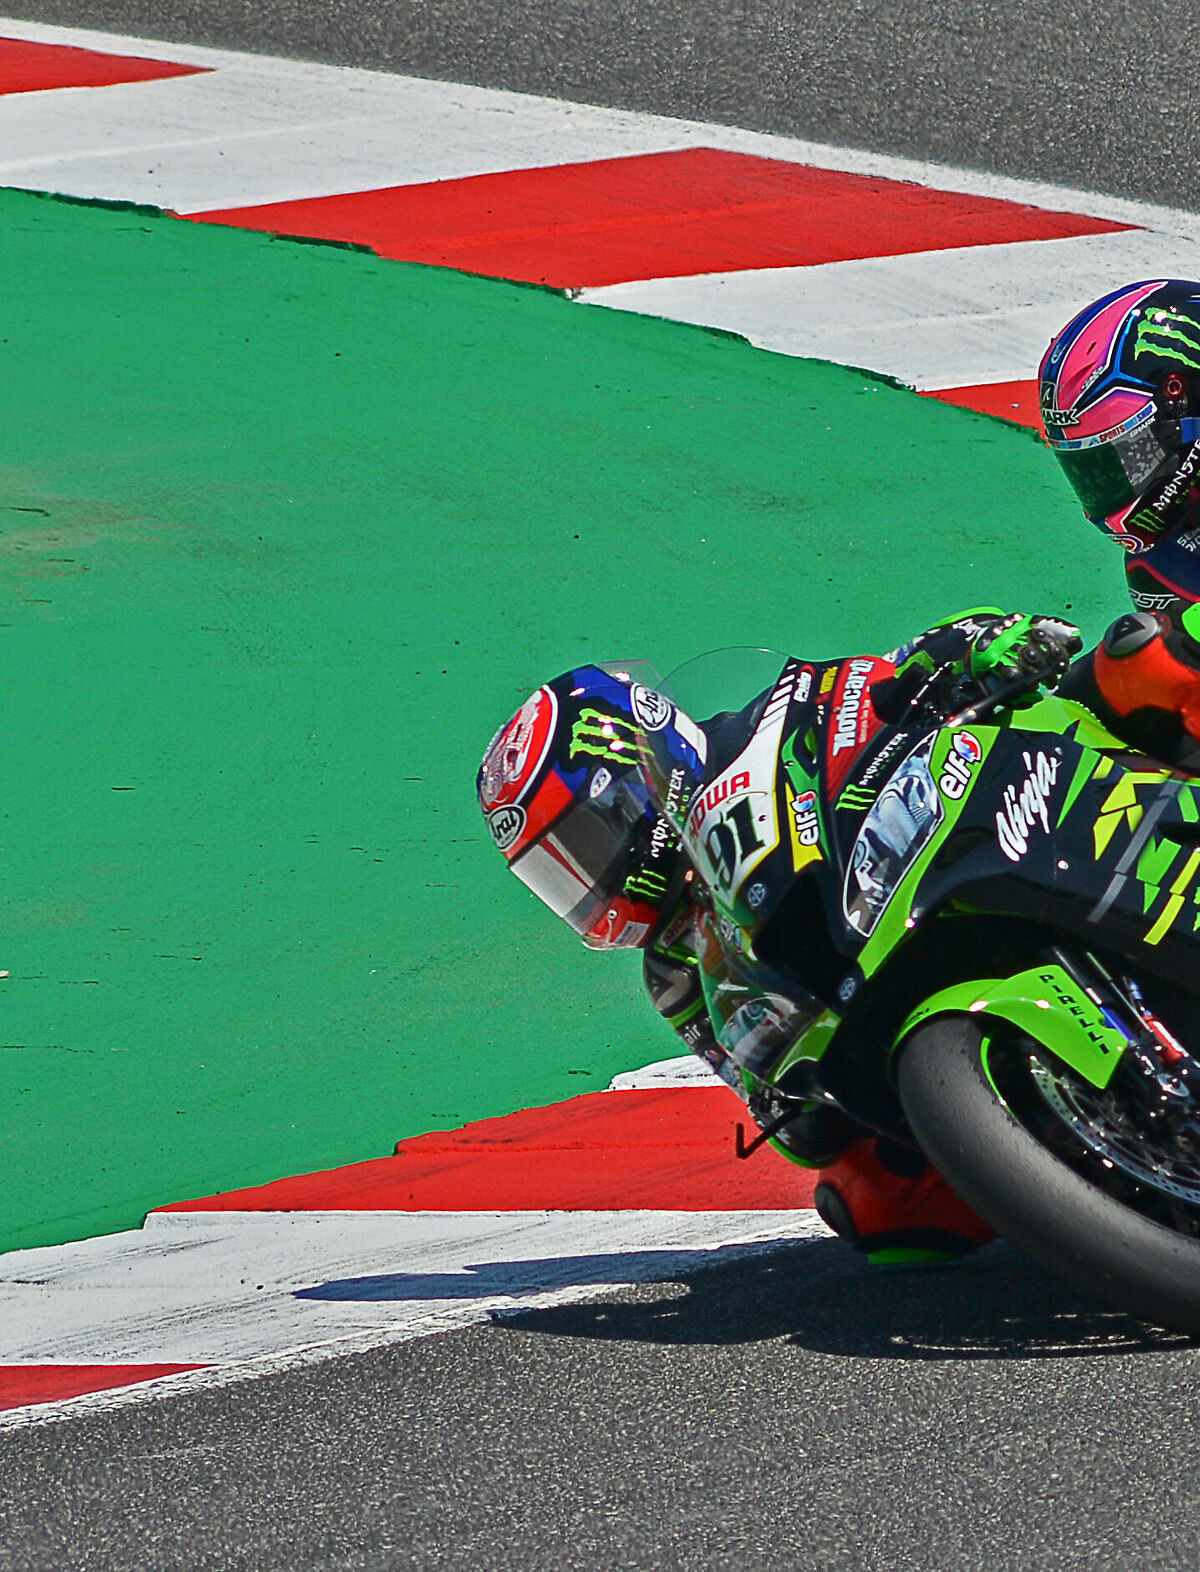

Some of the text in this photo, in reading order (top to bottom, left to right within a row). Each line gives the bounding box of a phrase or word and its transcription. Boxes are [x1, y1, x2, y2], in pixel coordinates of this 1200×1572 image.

[860, 731, 909, 786] MONSTER
[940, 752, 974, 800] elf
[688, 771, 750, 839] HOWA
[799, 799, 820, 847] elf
[996, 747, 1062, 862] Ninja
[1039, 974, 1109, 1055] PIRELLI
